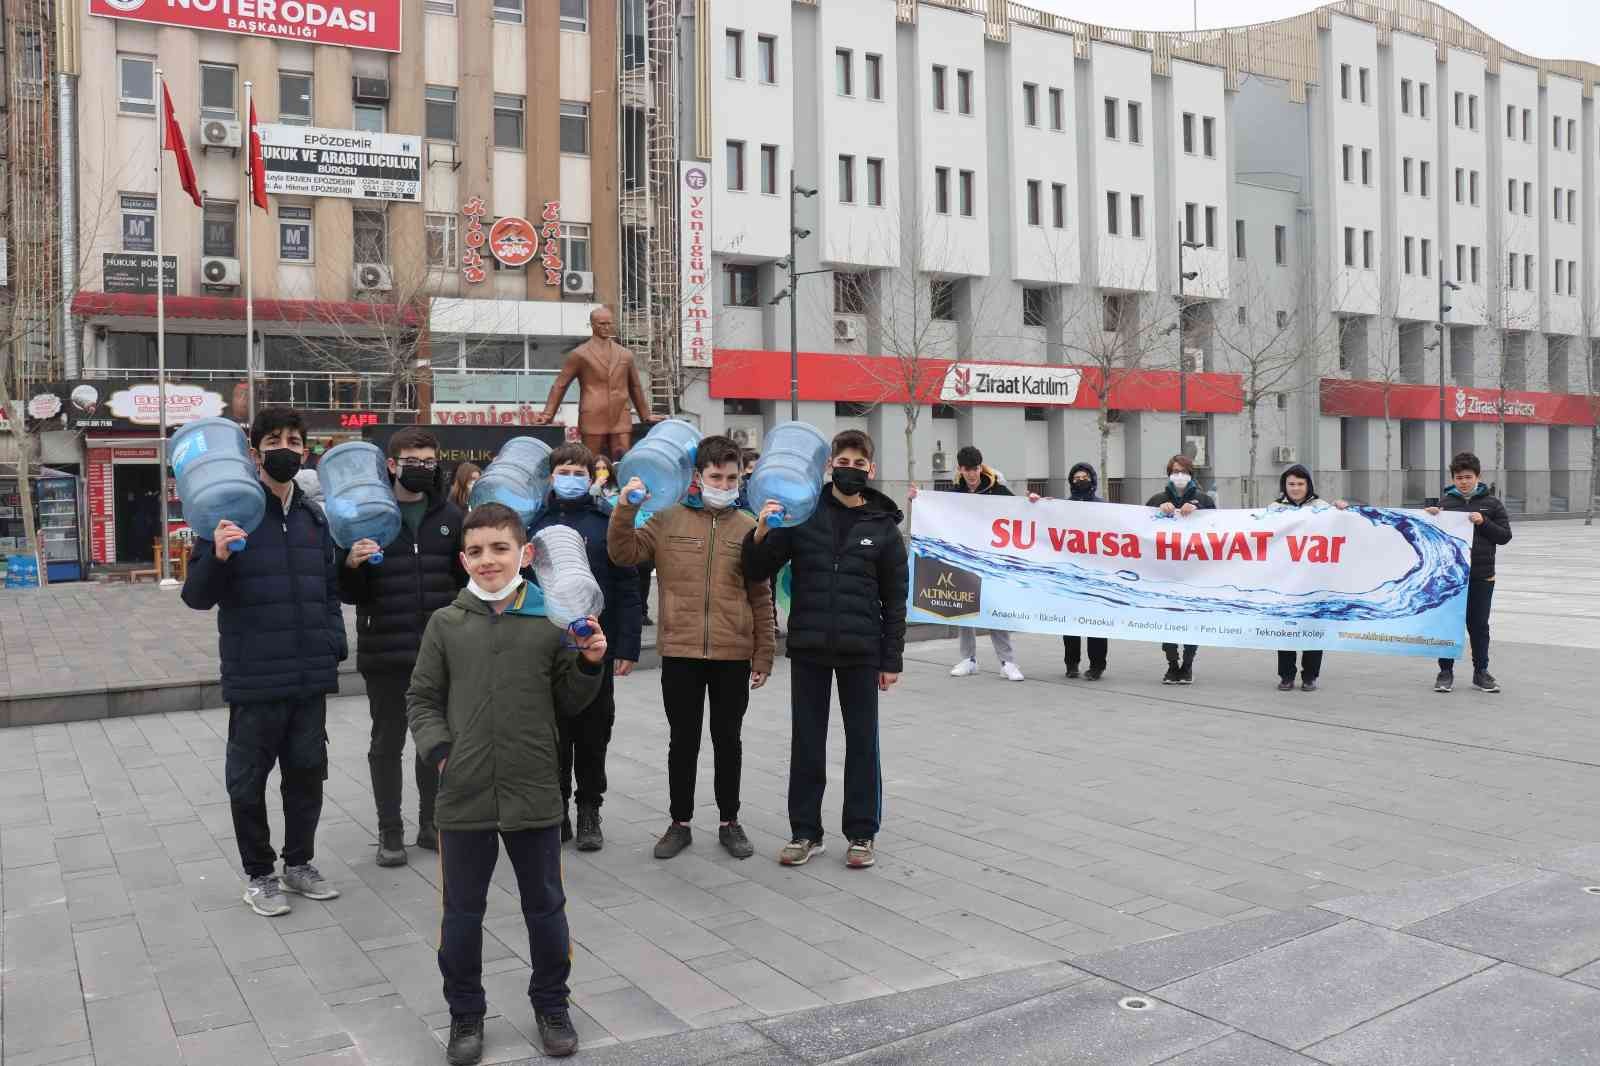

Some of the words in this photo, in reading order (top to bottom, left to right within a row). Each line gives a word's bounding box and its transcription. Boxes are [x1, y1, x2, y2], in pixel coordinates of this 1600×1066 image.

[281, 0, 375, 32] ODASI
[228, 18, 317, 38] BAŞKANLIĞI
[304, 134, 372, 148] EPÖZDEMİR
[302, 149, 318, 162] VE
[321, 150, 416, 170] ARABULUCULUK
[318, 164, 357, 176] BÜROSU
[687, 196, 704, 285] yenigün
[106, 258, 137, 267] HUKUK
[687, 295, 708, 361] emlak
[976, 373, 1020, 395] Ziraat
[1022, 375, 1069, 396] Katılım
[435, 405, 546, 426] yenigü
[437, 449, 493, 461] MENLIK
[990, 518, 1036, 550] SU
[1047, 526, 1142, 559] varsa
[1155, 531, 1274, 561] HAYAT
[1286, 534, 1346, 563] var
[991, 609, 1030, 621] Anaokulu
[1078, 616, 1115, 627] Ortaokul
[1127, 620, 1163, 630] Anadolu
[1164, 623, 1188, 632] Lisesi
[1200, 625, 1217, 634] Fen
[1219, 626, 1242, 635] Lisesi
[1255, 627, 1300, 639] Teknokent
